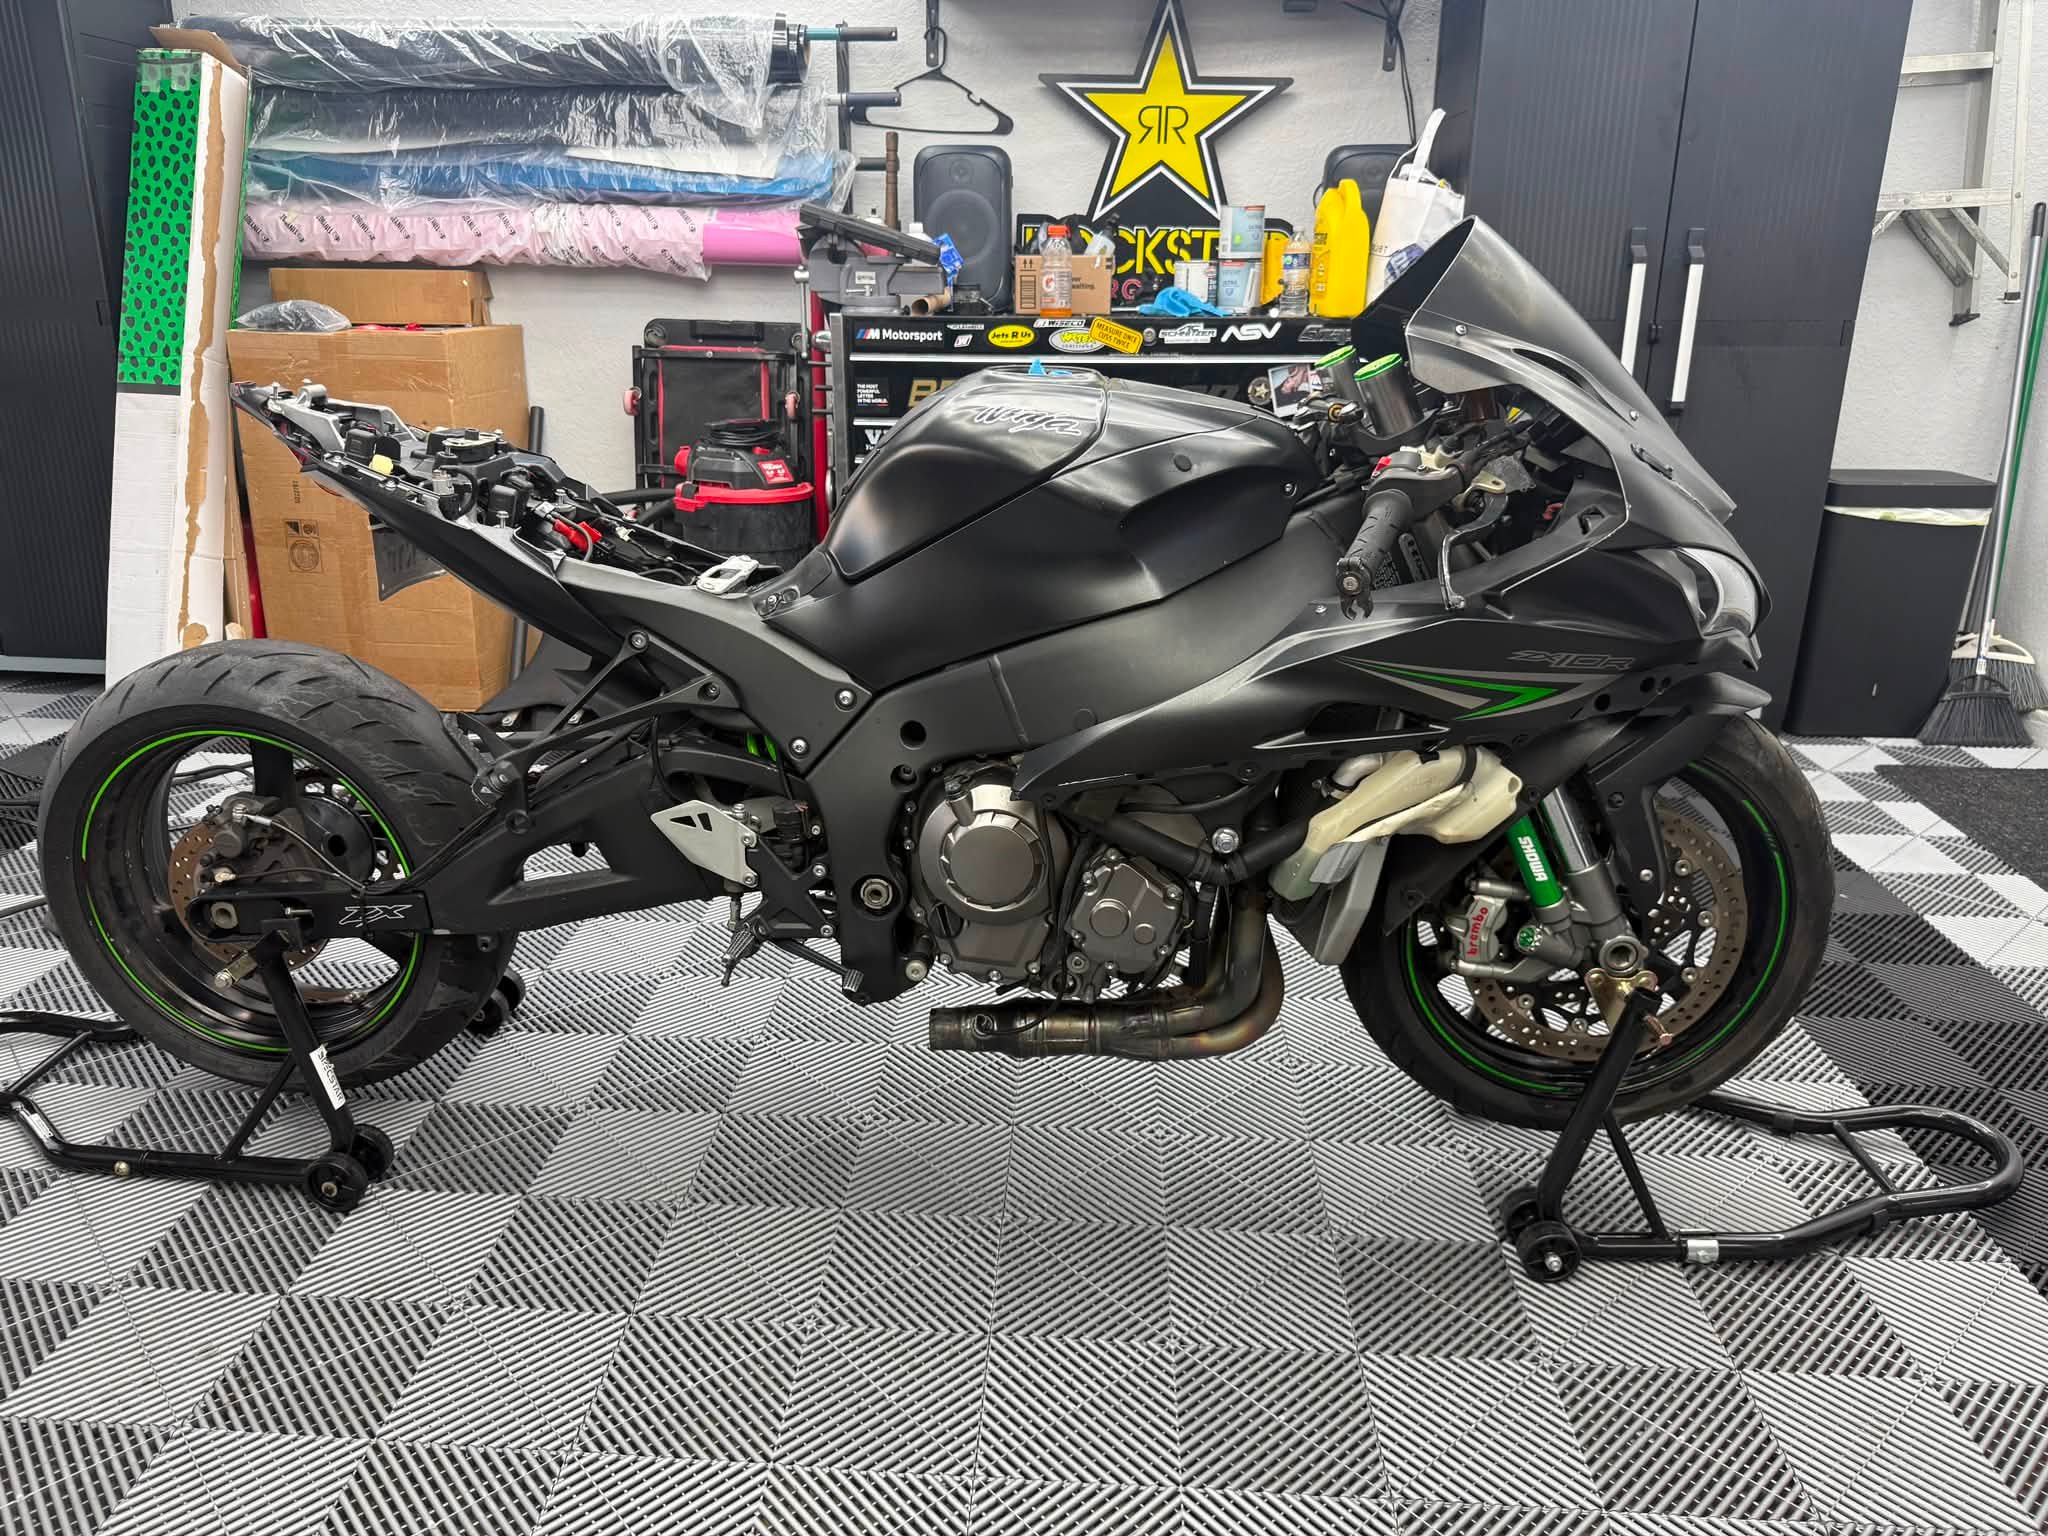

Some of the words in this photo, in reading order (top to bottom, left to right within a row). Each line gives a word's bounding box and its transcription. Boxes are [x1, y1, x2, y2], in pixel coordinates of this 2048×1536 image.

[882, 328, 943, 343] Motorsport
[1011, 331, 1019, 339] R
[1096, 321, 1123, 338] MEASURE
[1121, 332, 1138, 344] ONCE
[1098, 332, 1114, 343] CUSS
[1113, 338, 1131, 350] TWICE
[1221, 321, 1282, 343] ASV
[973, 405, 1082, 435] Ninja
[1517, 835, 1548, 882] SHOWA
[338, 904, 414, 928] ZX
[1466, 906, 1489, 956] brembo
